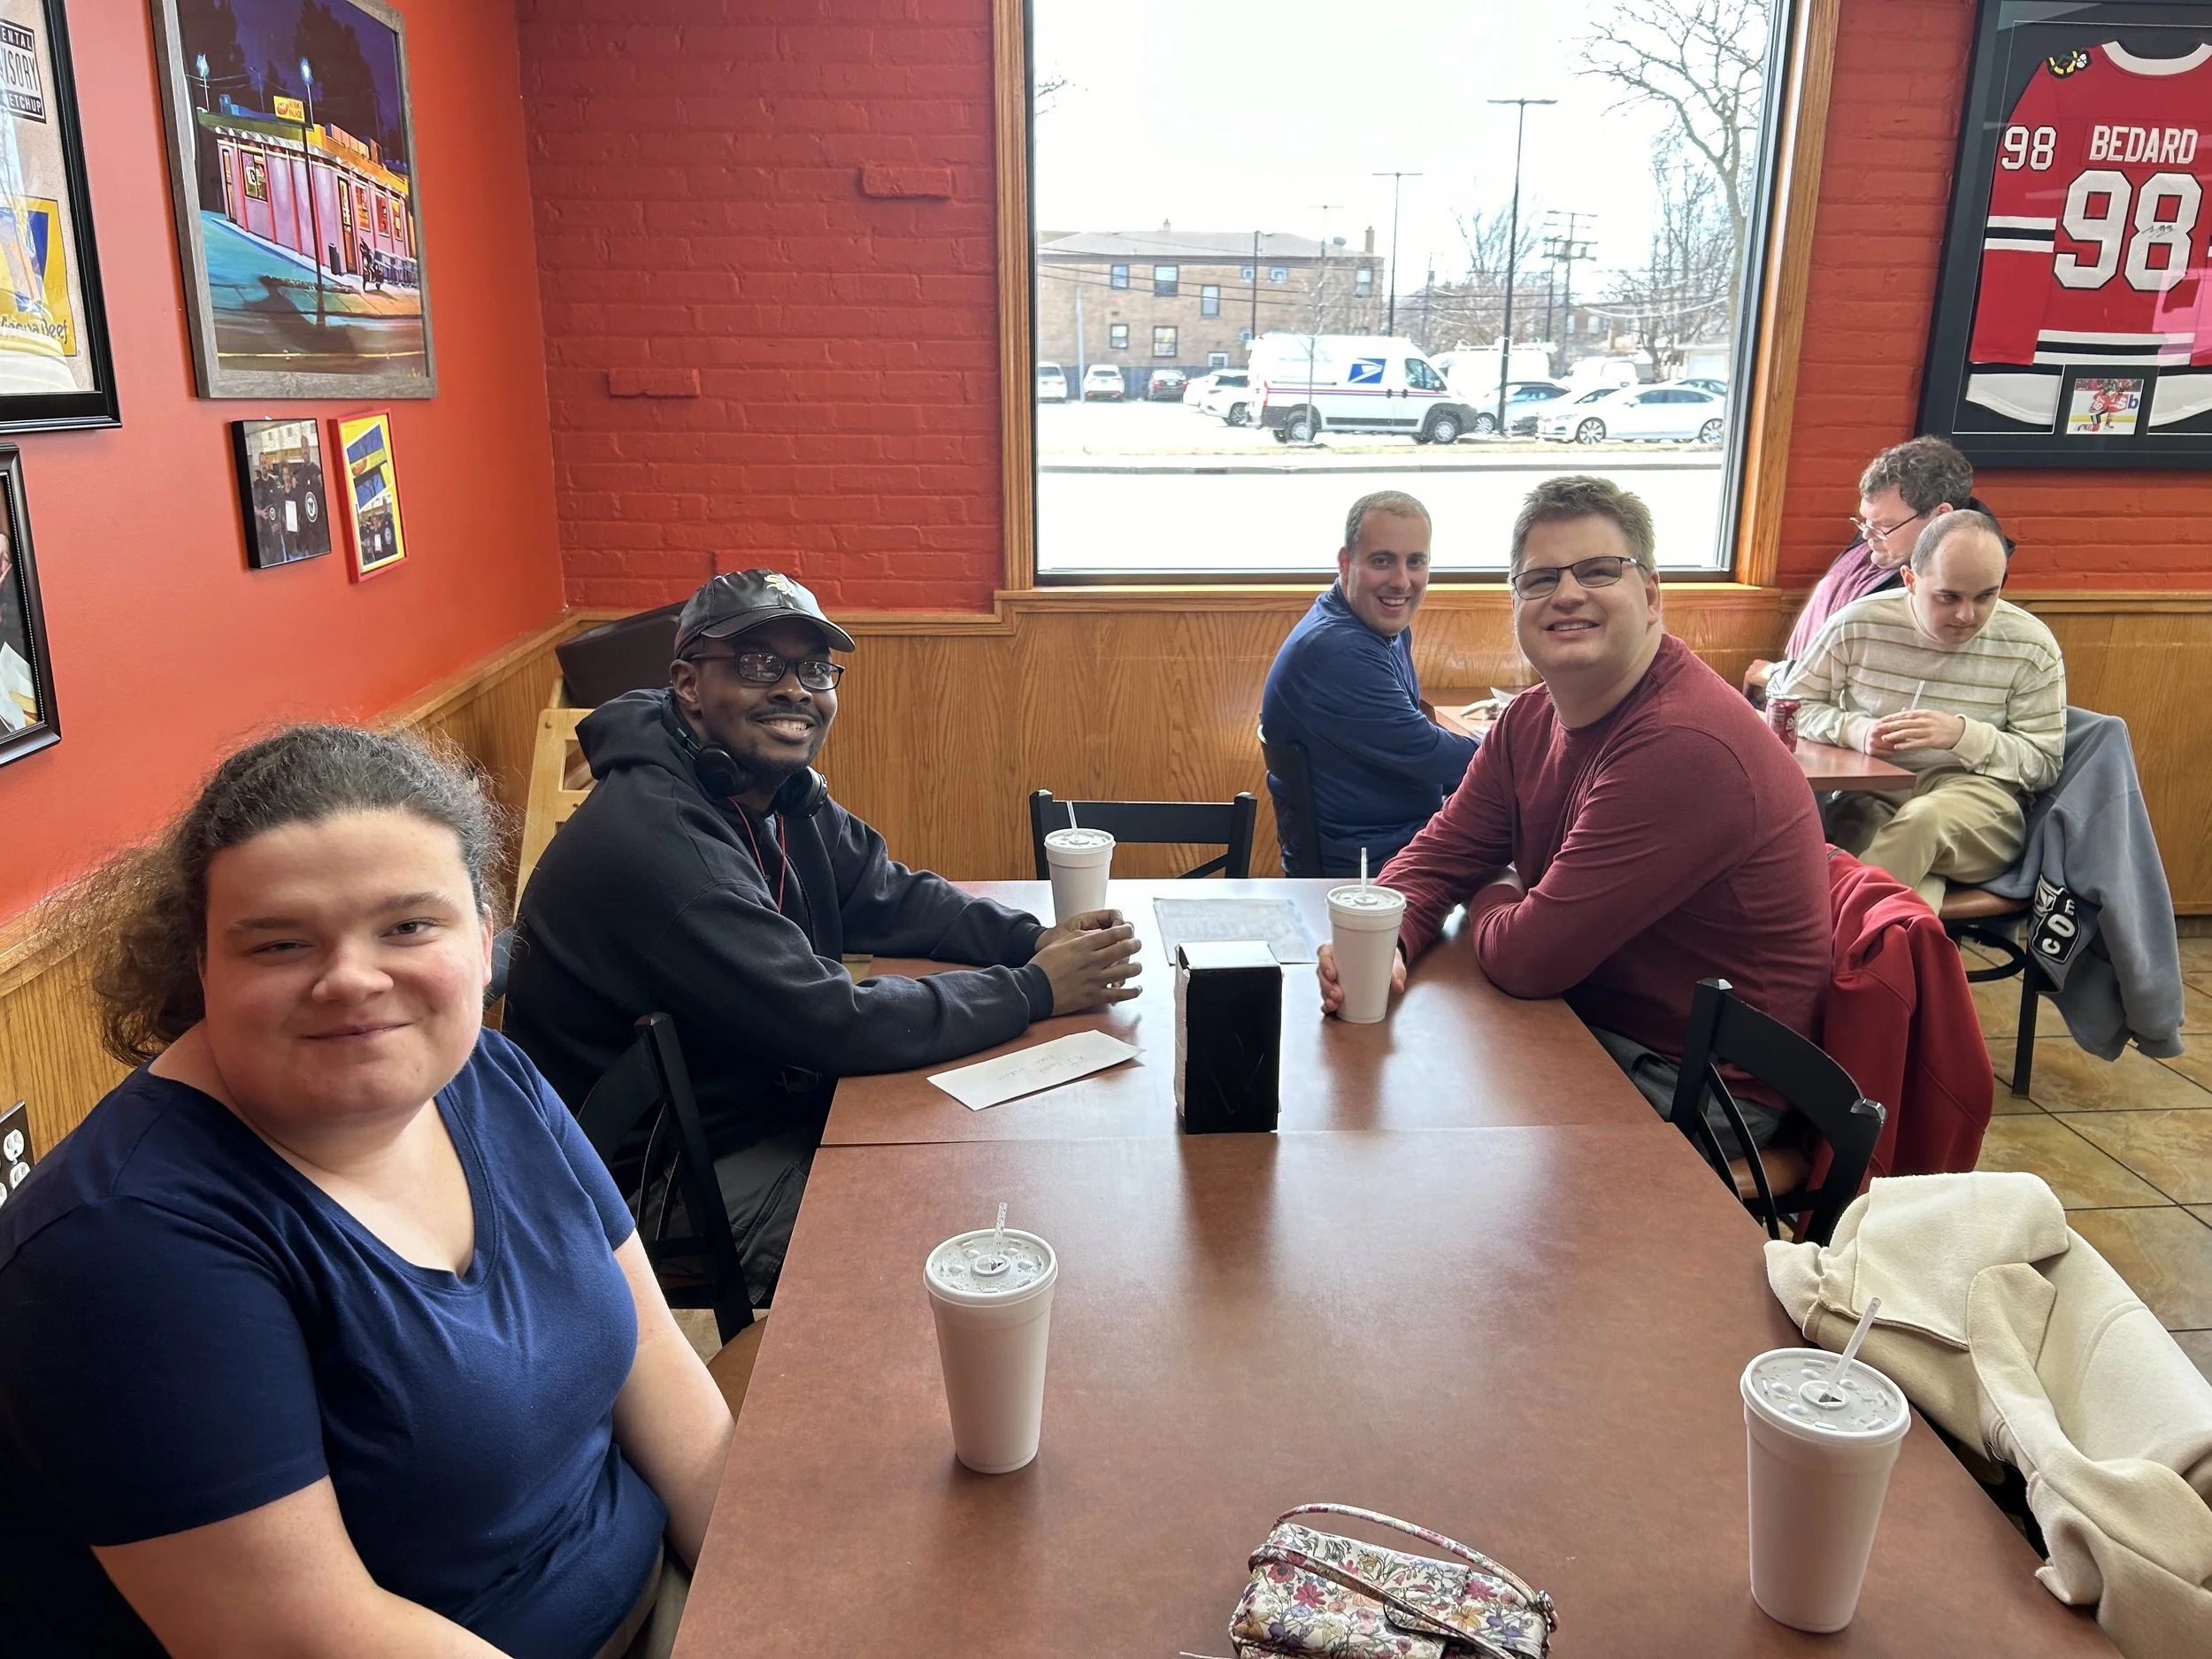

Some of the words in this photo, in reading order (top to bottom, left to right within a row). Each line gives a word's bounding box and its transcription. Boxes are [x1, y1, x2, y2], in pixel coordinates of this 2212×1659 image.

[2001, 125, 2057, 171] 98
[2089, 125, 2199, 165] BEDARD
[2052, 168, 2204, 293] 98
